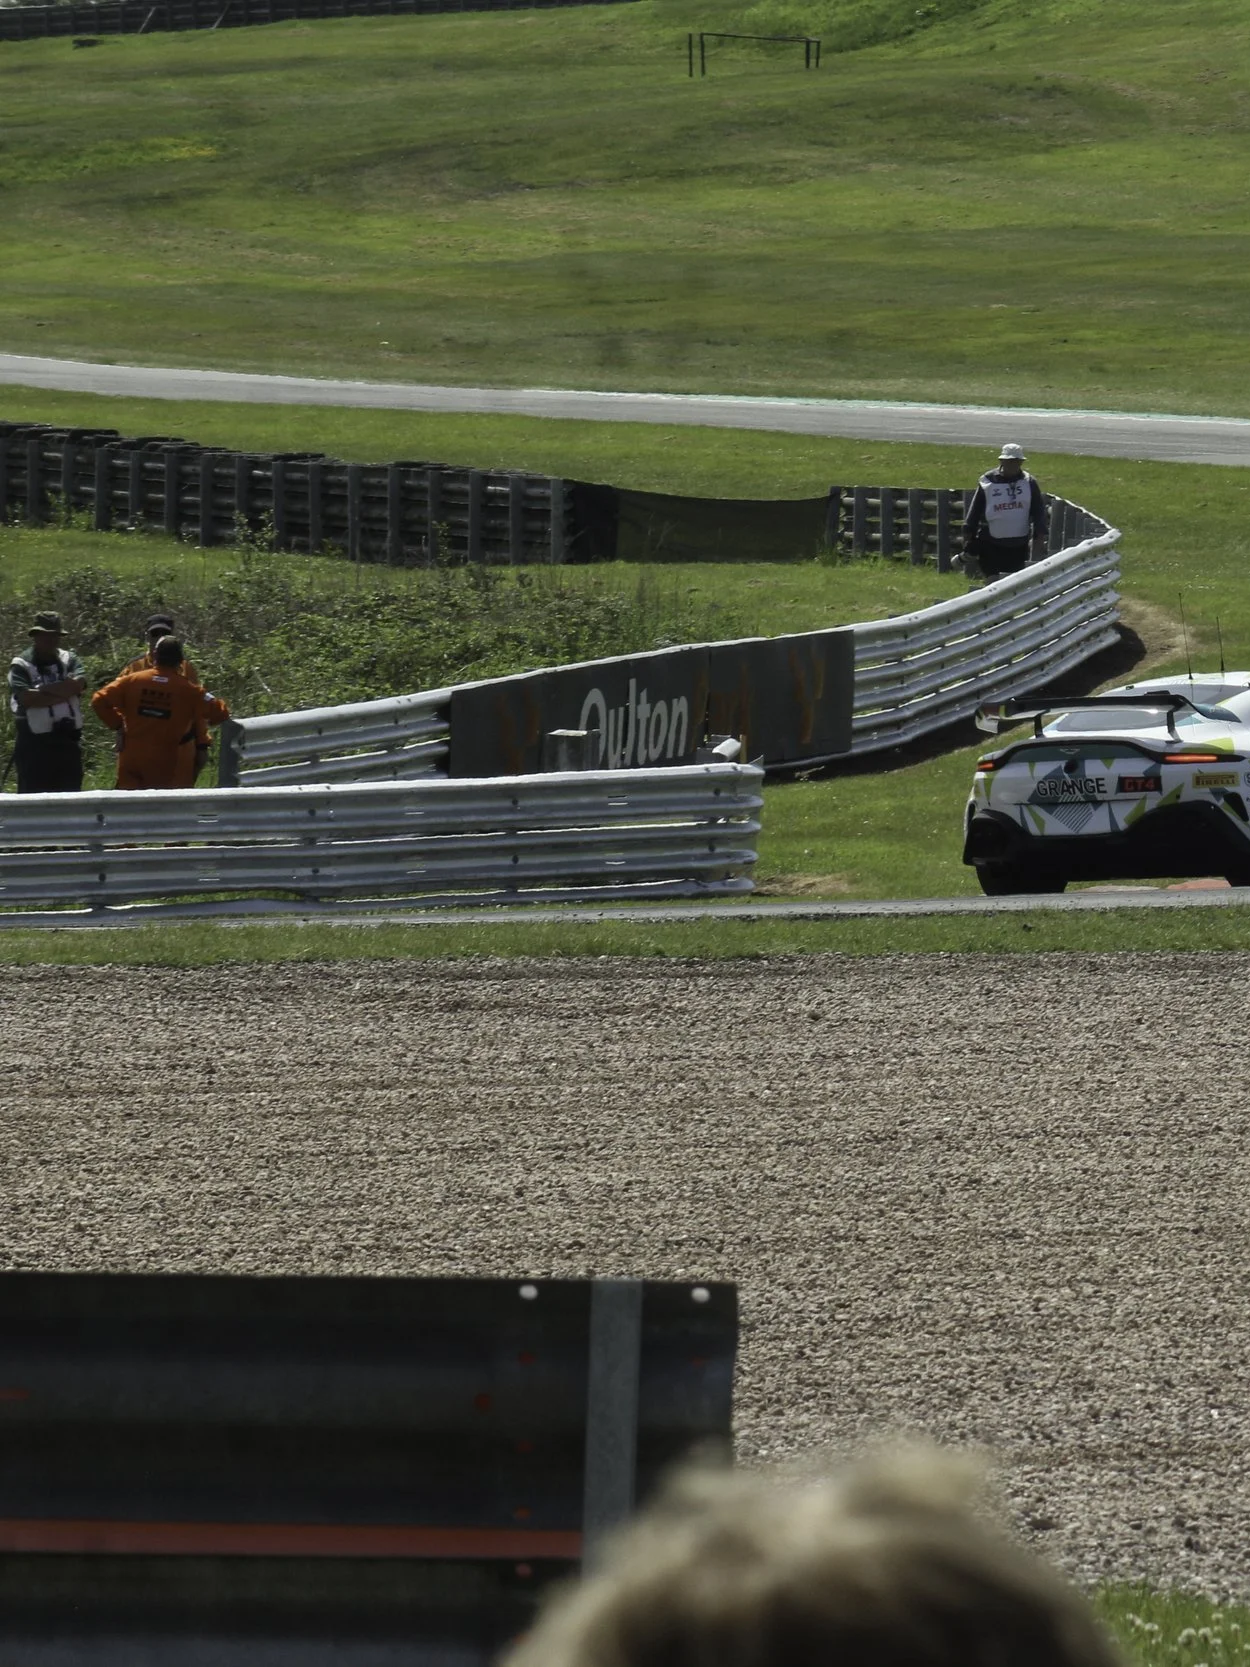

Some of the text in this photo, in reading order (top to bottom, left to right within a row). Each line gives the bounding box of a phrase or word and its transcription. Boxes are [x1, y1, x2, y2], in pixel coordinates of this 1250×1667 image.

[579, 677, 688, 769] Oulton
[1037, 778, 1107, 796] GRANGE
[1123, 778, 1155, 792] GT4
[1195, 775, 1235, 786] PIRELLI
